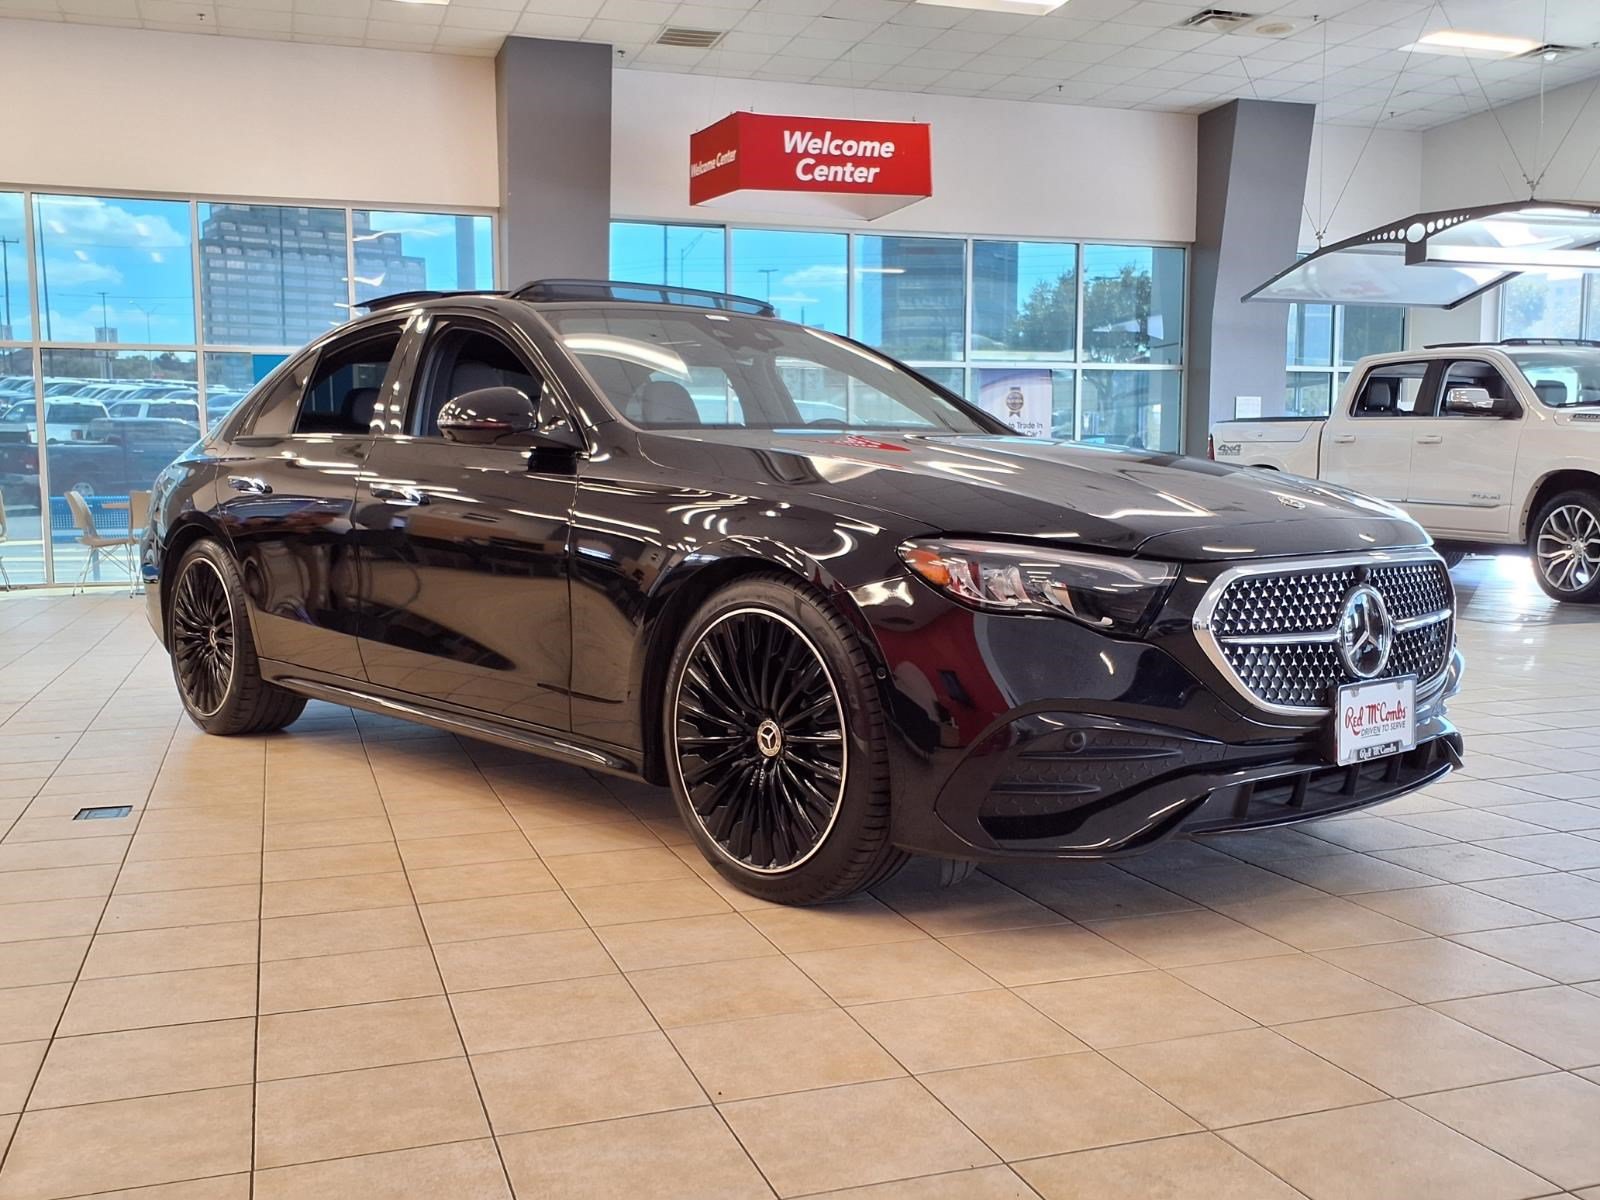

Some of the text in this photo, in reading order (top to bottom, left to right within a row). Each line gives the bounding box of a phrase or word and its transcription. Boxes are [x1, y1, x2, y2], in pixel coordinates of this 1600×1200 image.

[783, 130, 895, 158] Welcome
[690, 149, 737, 178] Welcome Center
[796, 158, 881, 184] Center
[1345, 700, 1406, 736] Red McCombs
[1361, 720, 1406, 736] DRIVEN TO SERVE
